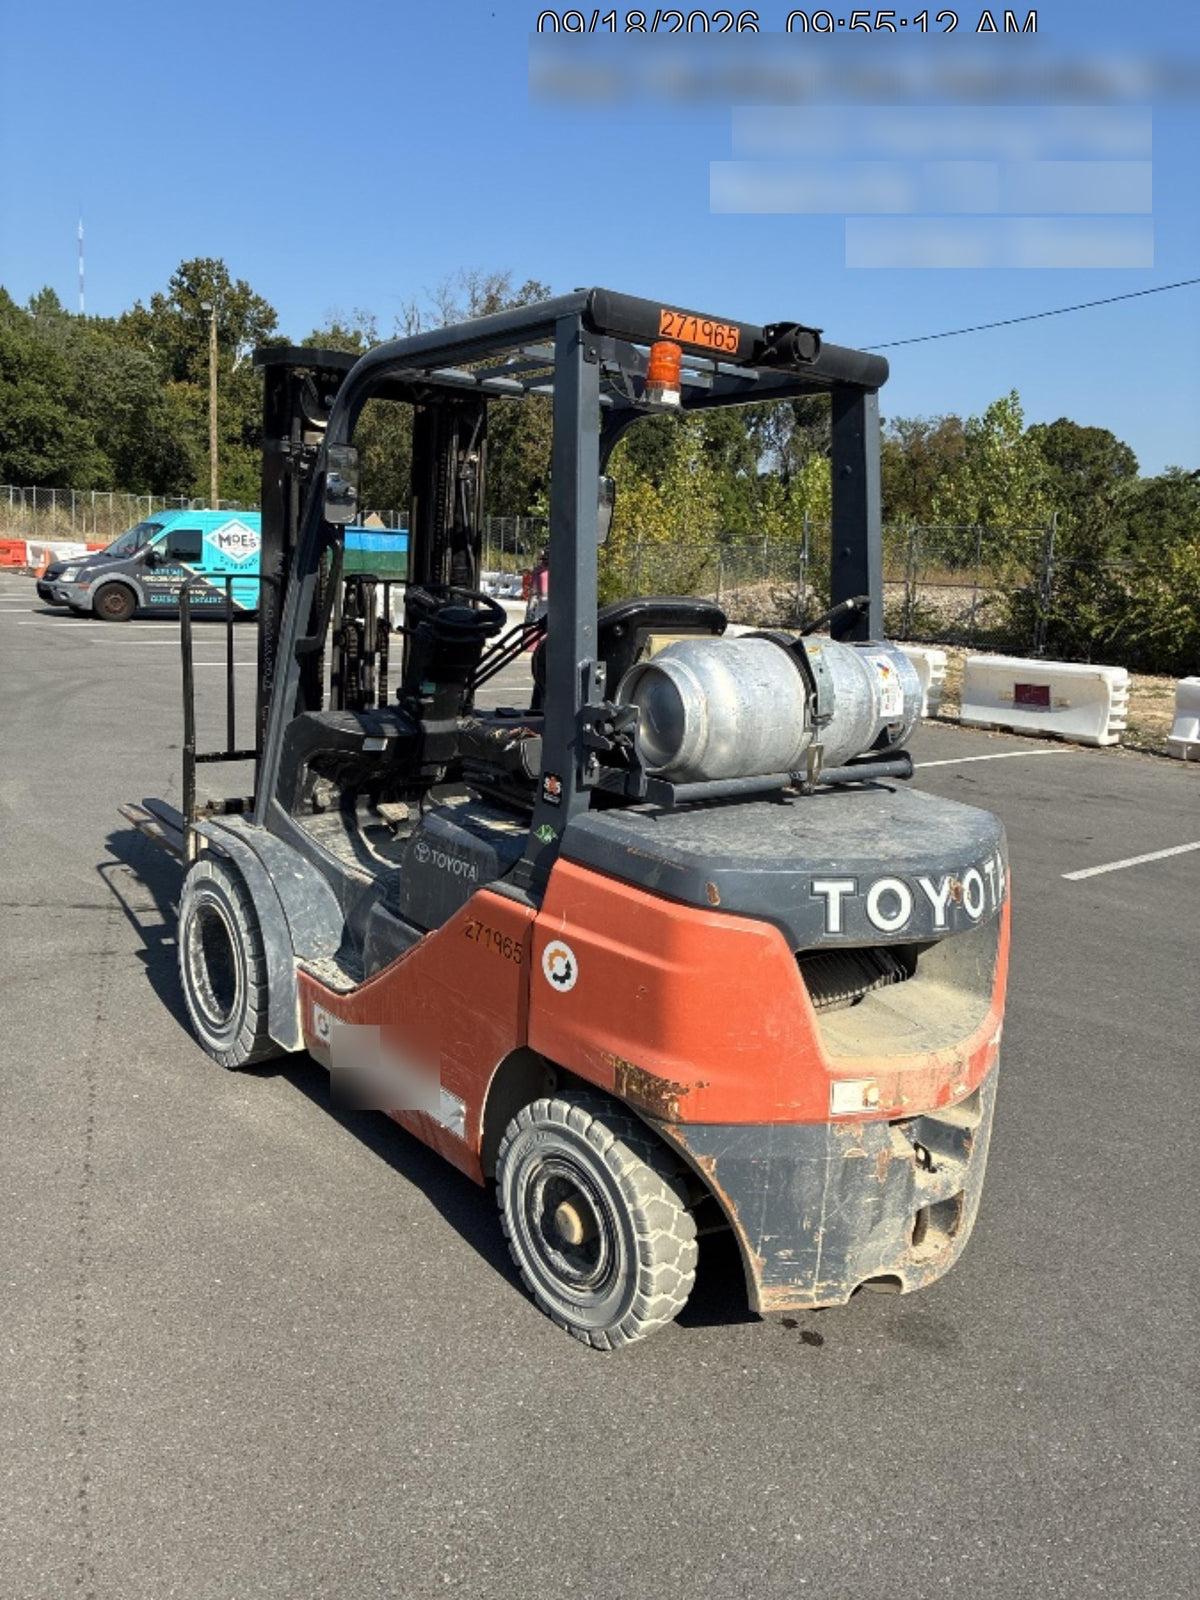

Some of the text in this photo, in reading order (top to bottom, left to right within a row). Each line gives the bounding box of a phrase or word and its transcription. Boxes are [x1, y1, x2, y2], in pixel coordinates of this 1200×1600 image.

[661, 312, 737, 350] 271965
[431, 849, 479, 881] TOYOTA
[812, 849, 1006, 933] TOYOTA
[464, 919, 523, 964] 271965
